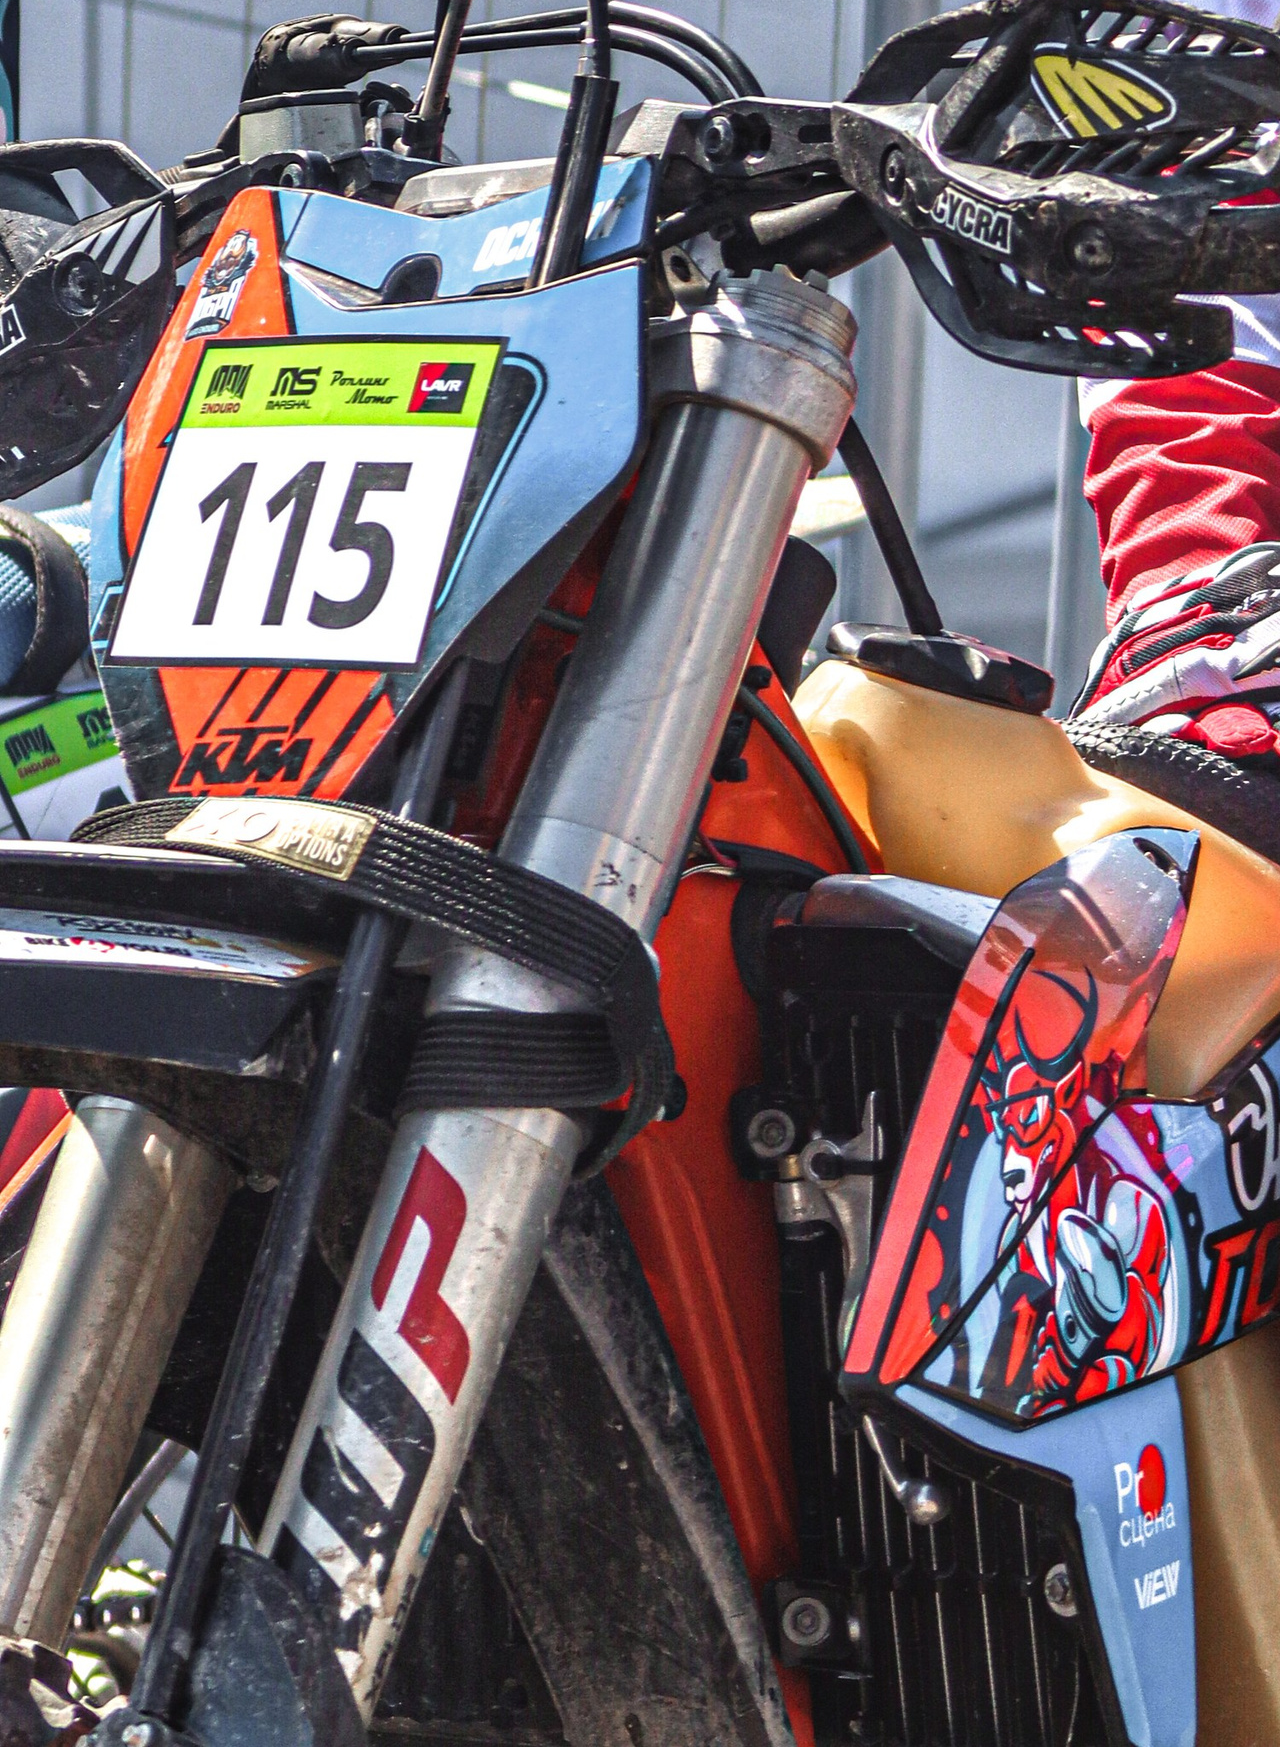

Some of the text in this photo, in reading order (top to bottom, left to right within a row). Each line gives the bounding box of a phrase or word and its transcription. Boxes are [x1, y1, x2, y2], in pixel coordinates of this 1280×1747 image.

[930, 187, 1012, 254] CYCRA
[265, 400, 312, 410] MARSHAL
[421, 379, 463, 392] LAVR
[200, 403, 241, 414] ENDURO
[192, 461, 413, 630] 115
[175, 726, 313, 785] KTM
[275, 831, 348, 867] OPTIONS
[1119, 1501, 1176, 1548] сцена
